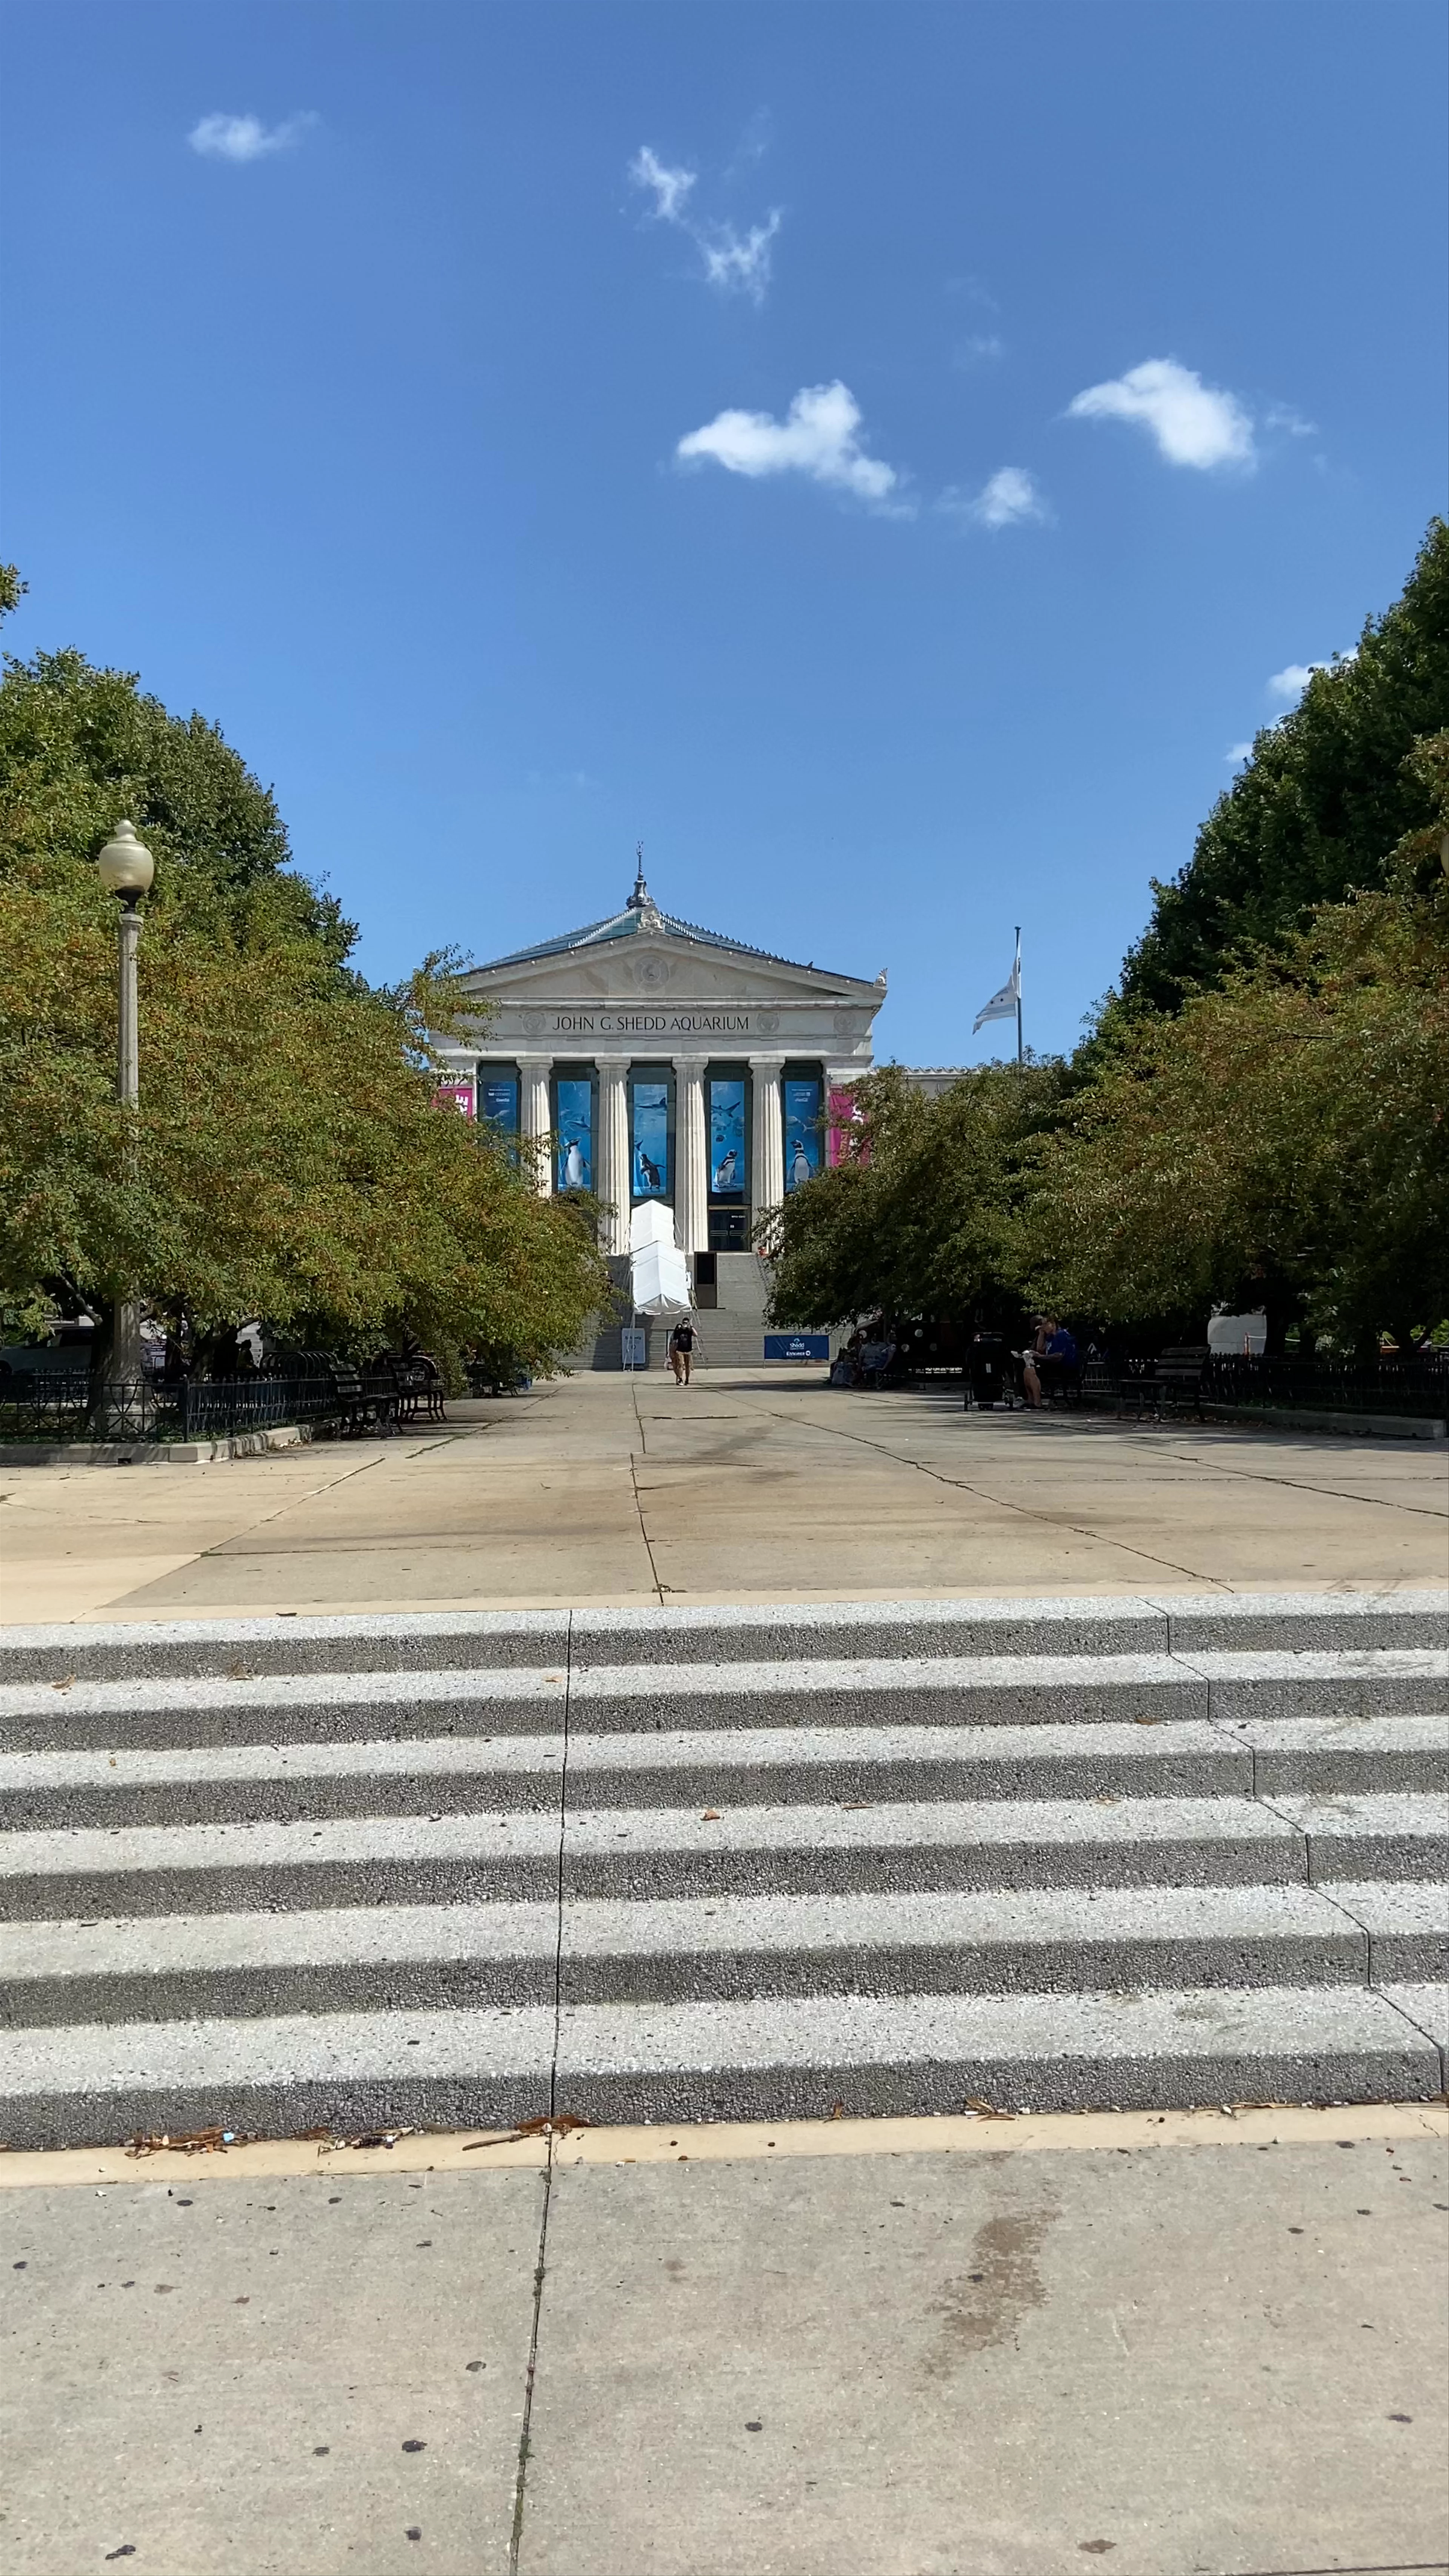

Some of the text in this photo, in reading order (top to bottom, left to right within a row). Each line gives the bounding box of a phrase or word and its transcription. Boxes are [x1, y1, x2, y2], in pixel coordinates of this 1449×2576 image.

[552, 1016, 748, 1031] JOHN G. SHEDD AQUARIUM
